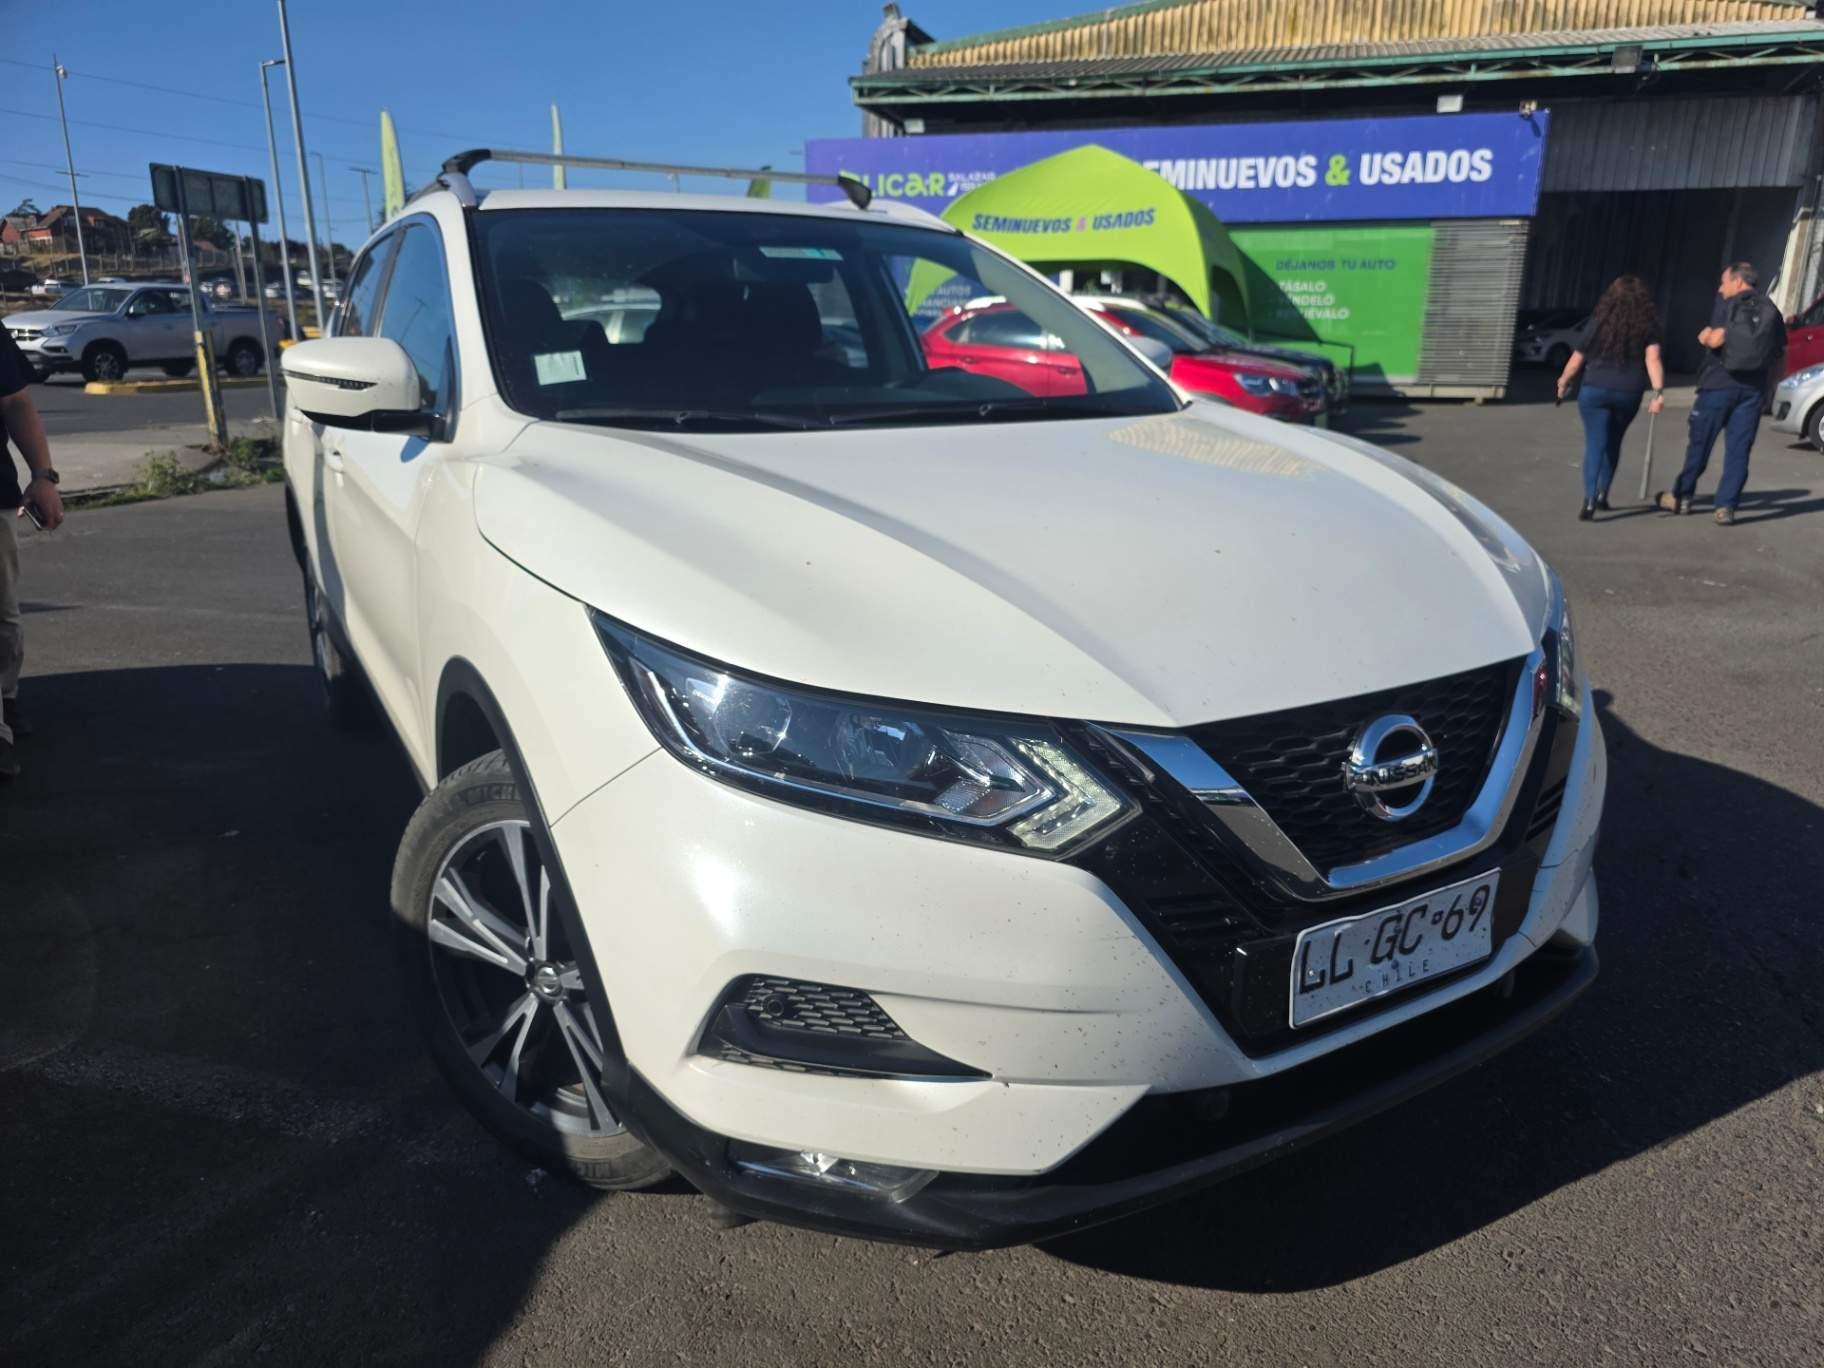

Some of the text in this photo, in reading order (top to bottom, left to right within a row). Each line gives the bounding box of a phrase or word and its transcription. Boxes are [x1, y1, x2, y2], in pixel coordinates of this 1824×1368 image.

[1139, 148, 1494, 190] MINUEVOS & USADOS
[972, 213, 1072, 234] SEMINUEVOS
[1092, 208, 1156, 231] USADOS
[1341, 259, 1357, 271] TU
[1359, 258, 1397, 271] AUTO
[1364, 959, 1430, 993] CHILE
